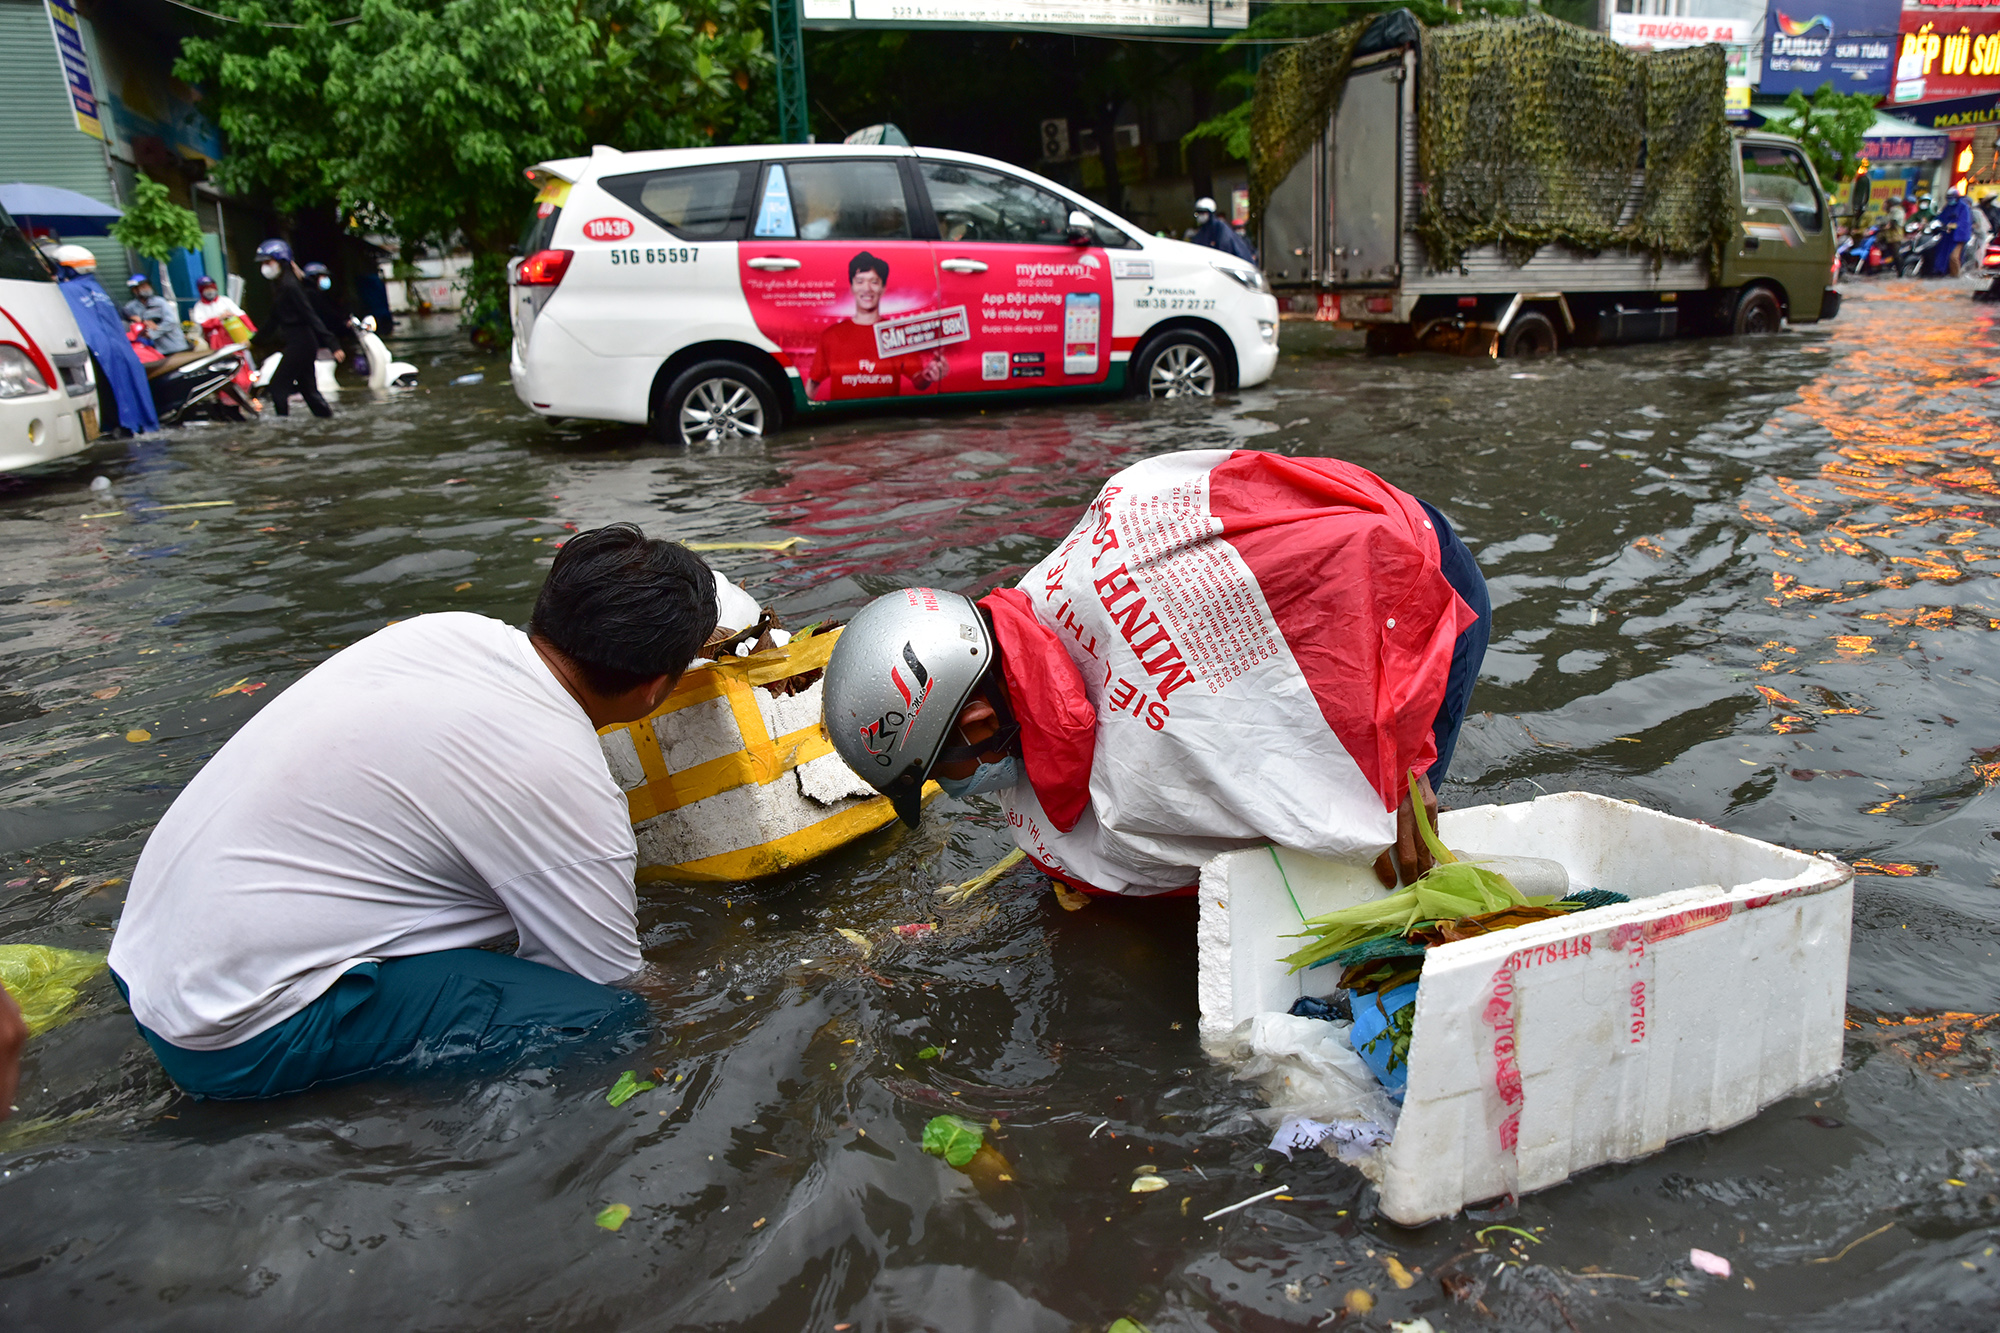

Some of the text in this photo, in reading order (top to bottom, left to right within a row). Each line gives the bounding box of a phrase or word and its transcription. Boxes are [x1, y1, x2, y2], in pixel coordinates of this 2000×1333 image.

[1638, 22, 1734, 41] TRƯỜNG SA
[1772, 32, 1823, 56] Dulux
[1942, 26, 1971, 76] VŨ
[589, 220, 630, 236] 10436
[611, 248, 699, 264] 51G 65597
[1016, 263, 1084, 279] mytour.vn
[982, 292, 1062, 306] App Đặt phòng
[1152, 300, 1167, 308] 38
[1171, 300, 1184, 309] 27
[1188, 300, 1200, 309] 27
[1204, 300, 1216, 310] 27
[982, 308, 1044, 320] Vé máy bay
[858, 360, 876, 372] Fly
[842, 373, 893, 386] mytour.vn
[1135, 525, 1146, 544] BÌNH
[1218, 550, 1239, 577] THÀNH,
[1196, 572, 1216, 600] CHINH,
[1203, 562, 1228, 599] KHƯƠNG,
[1230, 576, 1249, 593] TẤT
[1160, 580, 1178, 603] TTHC
[1179, 588, 1196, 609] LINH
[1190, 582, 1206, 605] LĨNH,
[1174, 601, 1189, 621] KHU
[1201, 604, 1213, 618] BỘ
[1223, 598, 1236, 617] VĂN
[1232, 590, 1248, 615] KHOA
[1239, 592, 1264, 627] NGUYỄN
[1162, 601, 1183, 633] TRUNG,
[1192, 607, 1201, 618] P.
[1211, 599, 1232, 634] TRƯỜNG
[1055, 598, 1098, 661] THỊ
[1186, 619, 1195, 631] M,
[1197, 616, 1207, 631] 1K,
[1208, 617, 1223, 638] ĐINH
[1231, 616, 1242, 629] LÊ
[1241, 614, 1255, 632] THỦ
[1260, 625, 1270, 637] 39
[1093, 562, 1197, 703] MINH
[1204, 630, 1214, 644] QL
[1237, 627, 1251, 647] 117A
[1251, 631, 1260, 642] 19
[1180, 631, 1200, 662] QUANG
[1191, 630, 1211, 660] ĐƯỜNG
[1218, 637, 1233, 659] 72-74
[1228, 633, 1243, 653] 824A
[1256, 641, 1269, 660] CS7:
[1265, 637, 1279, 655] CS8:
[1209, 642, 1224, 664] 58-60
[1238, 652, 1251, 672] CS5:
[1247, 647, 1260, 666] CS6:
[1196, 661, 1208, 676] 821
[1206, 660, 1216, 670] 27
[1221, 663, 1233, 683] CS3:
[1229, 658, 1242, 677] CS4:
[1206, 678, 1218, 694] CS1:
[1213, 671, 1225, 688] CS2:
[1027, 817, 1040, 844] THỊ
[1036, 842, 1054, 865] XE
